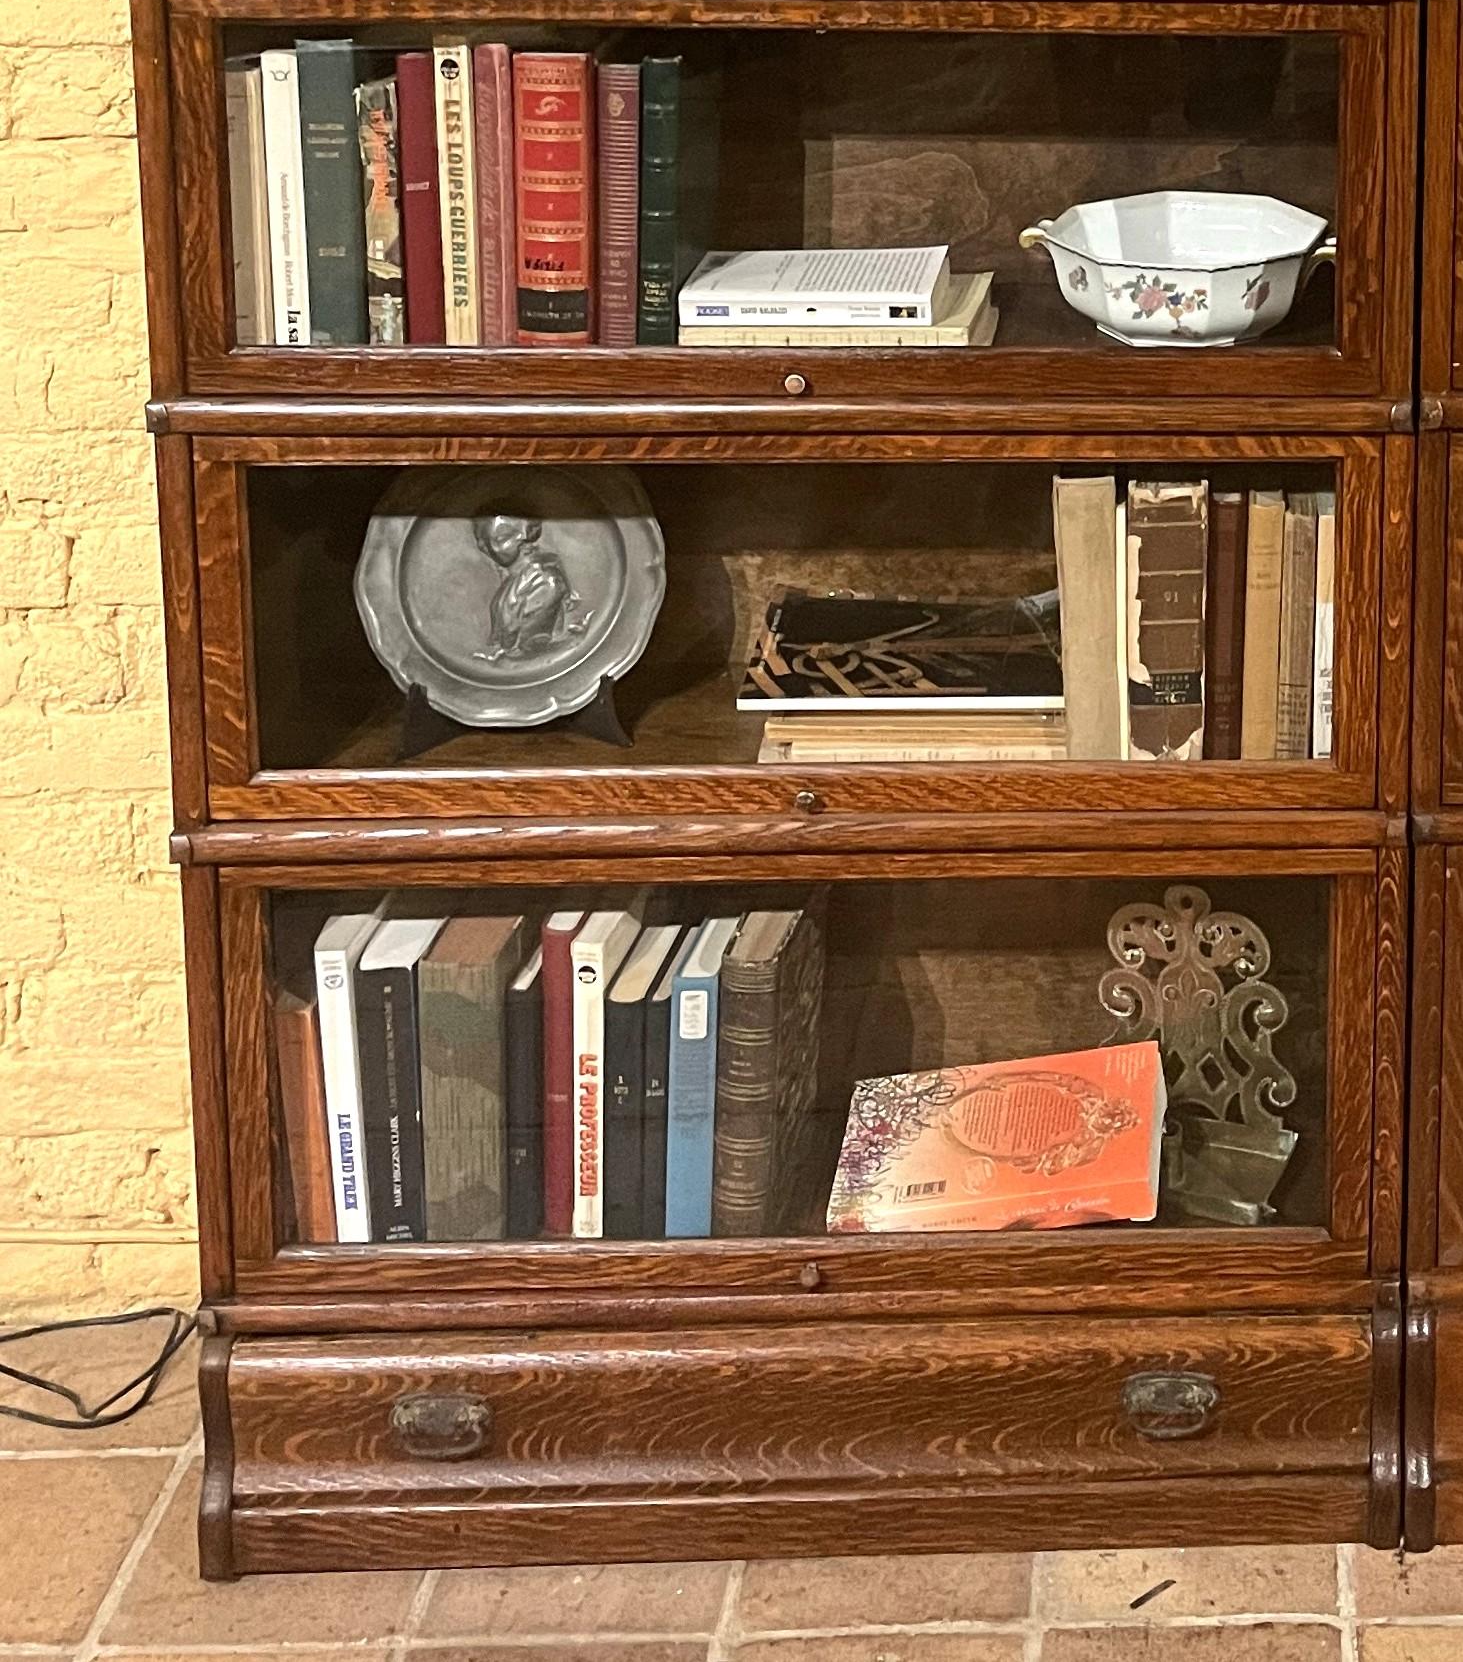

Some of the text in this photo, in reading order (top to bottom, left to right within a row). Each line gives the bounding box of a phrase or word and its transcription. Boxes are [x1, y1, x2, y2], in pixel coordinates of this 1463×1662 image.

[445, 99, 469, 308] LES LOUPS GUERRIERS
[287, 310, 301, 324] la
[288, 327, 299, 343] sa
[337, 1114, 351, 1129] LE
[579, 1054, 598, 1197] LE PROFESSEUR
[393, 1182, 403, 1207] MARY
